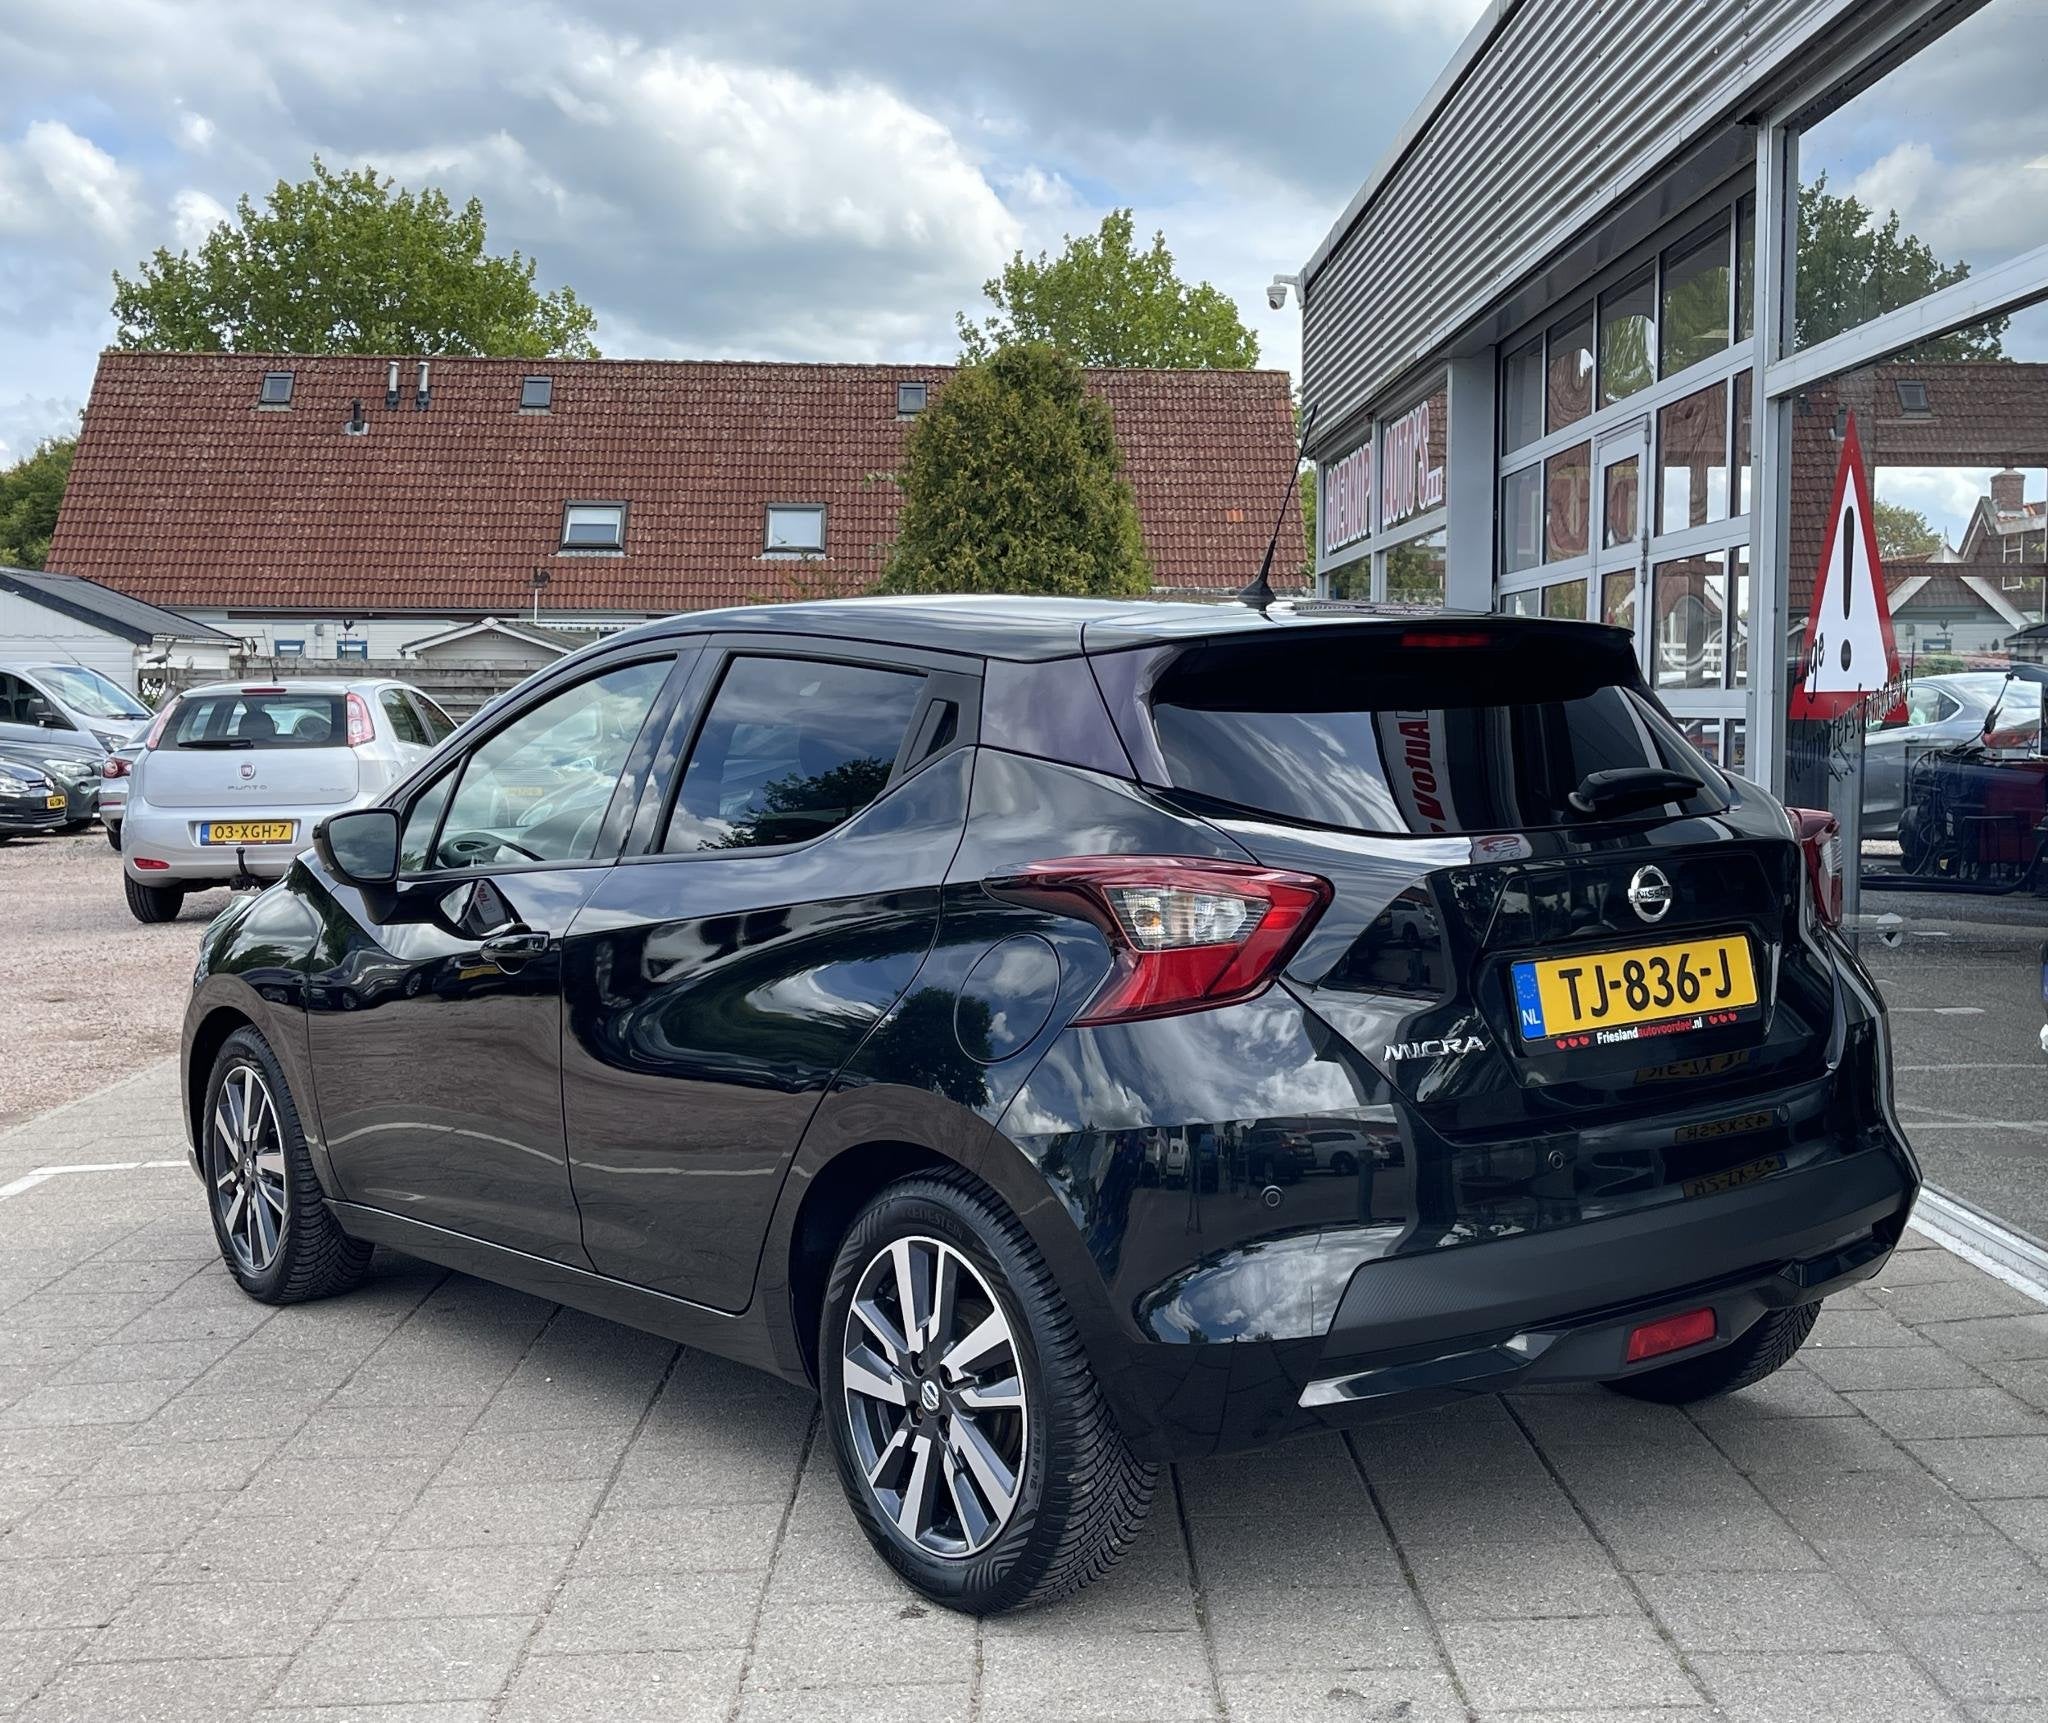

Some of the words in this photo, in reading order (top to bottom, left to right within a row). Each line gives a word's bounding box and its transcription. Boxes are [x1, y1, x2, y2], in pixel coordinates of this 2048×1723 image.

[1326, 439, 1373, 553] GOEDKOP
[214, 824, 287, 839] 03-XGH-7
[1522, 1009, 1541, 1026] NL
[1559, 949, 1732, 1020] TJ-836-J
[1384, 1036, 1486, 1061] MICRA
